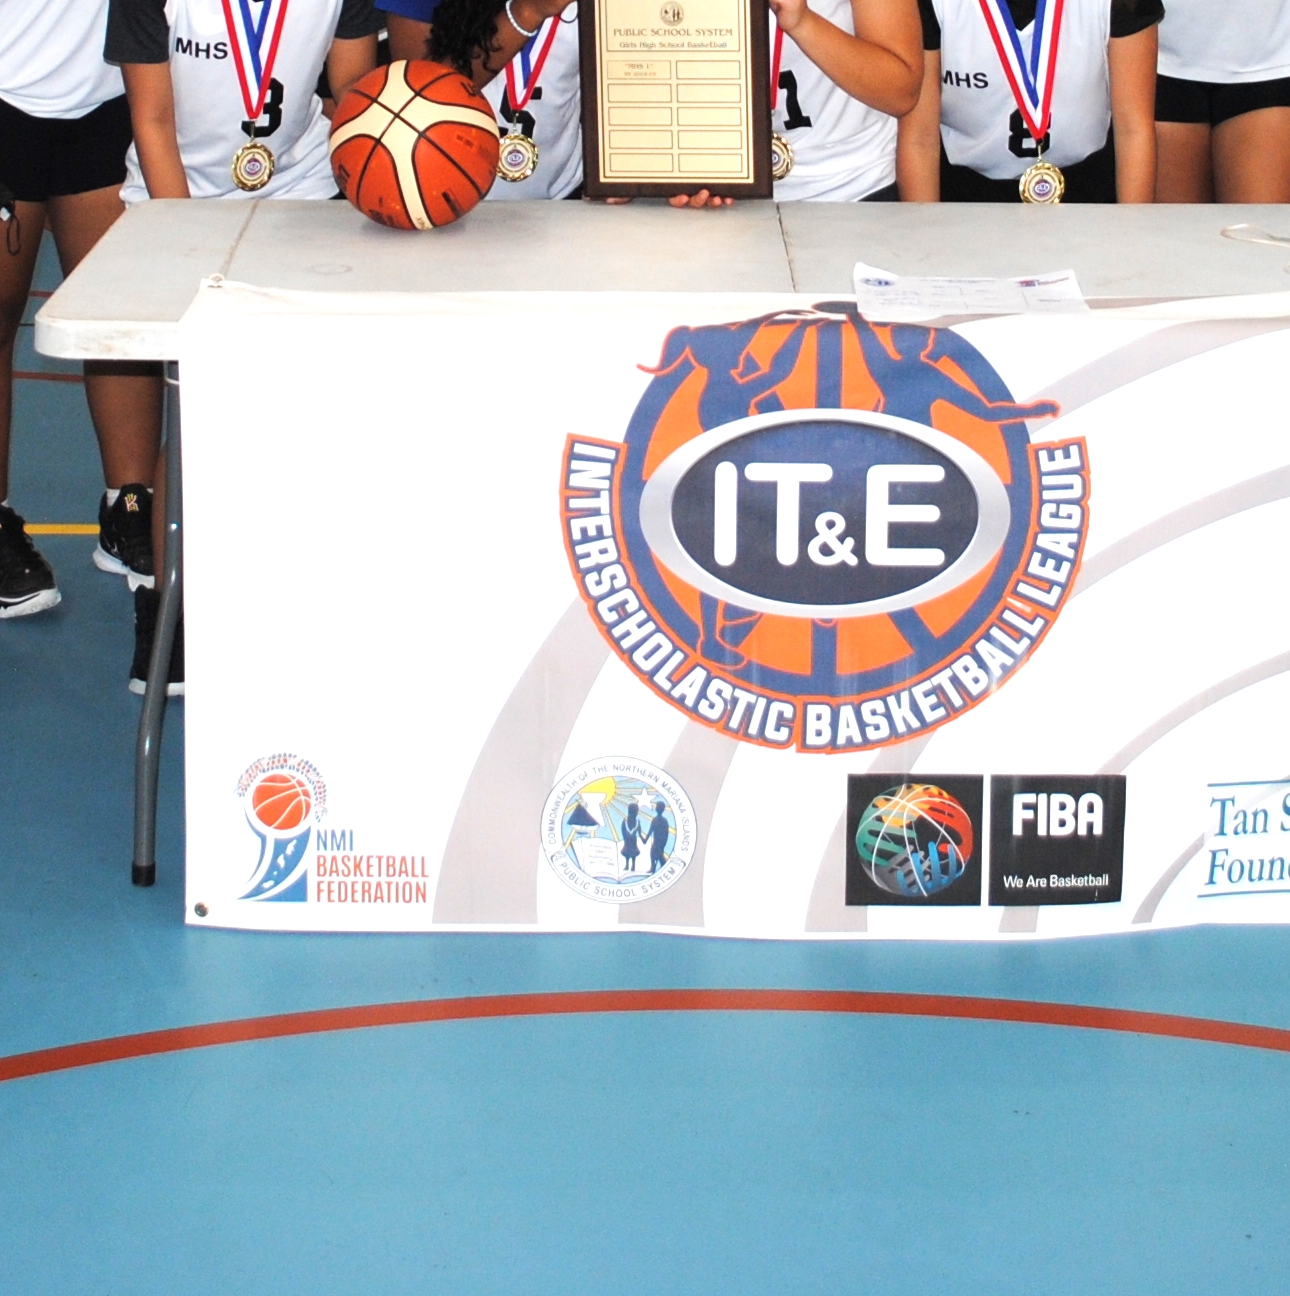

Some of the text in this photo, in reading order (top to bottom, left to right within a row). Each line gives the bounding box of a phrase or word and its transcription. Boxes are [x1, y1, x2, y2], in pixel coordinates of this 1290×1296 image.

[175, 37, 228, 60] MHS
[613, 28, 733, 37] PUBLIC SCHOOL SYSTEM
[1008, 108, 1051, 158] 8
[713, 460, 946, 567] IT&E
[567, 441, 1083, 745] INTERSCHOLASTIC BASKETBALL LEAGUE
[548, 778, 578, 845] COMMONWEALTH
[578, 771, 589, 782] OF
[592, 764, 609, 774] THE
[612, 763, 659, 783] NORTHERN
[661, 780, 687, 814] MARIANA
[1012, 792, 1104, 836] FIBA
[1210, 795, 1269, 837] Tan
[316, 829, 354, 851] NMI
[316, 855, 429, 878] BASKETBALL
[559, 861, 676, 898] PUBLIC SCHOOL SYSTEM
[1003, 873, 1109, 889] We Are Basketball
[316, 880, 427, 903] FEDERATION
